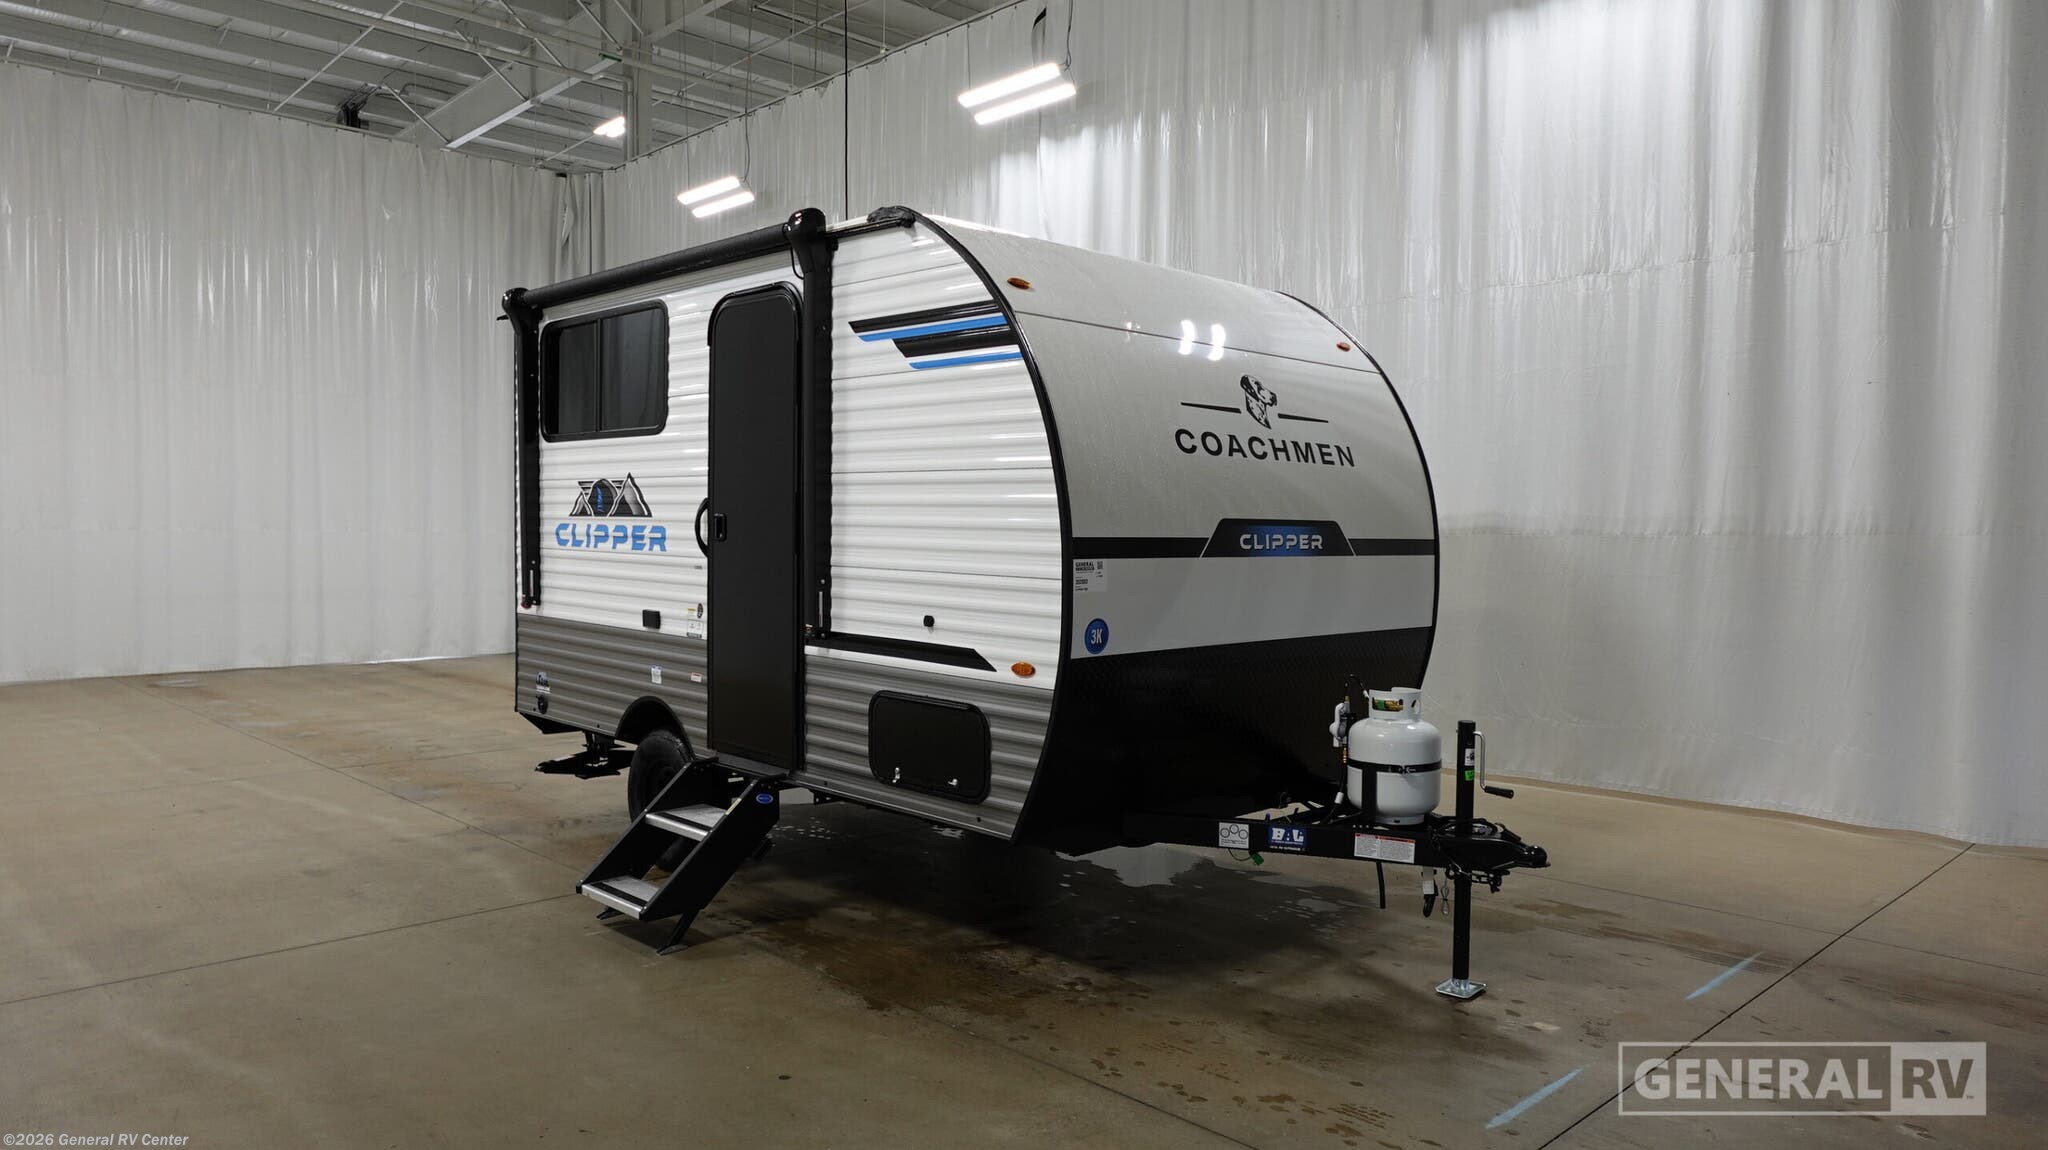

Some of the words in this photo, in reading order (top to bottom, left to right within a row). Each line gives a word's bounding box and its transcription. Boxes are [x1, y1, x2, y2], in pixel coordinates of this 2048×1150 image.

[1175, 428, 1355, 467] COACHMEN
[555, 523, 667, 552] CLIPPER
[1239, 534, 1323, 550] CLIPPER
[1091, 629, 1103, 644] 3K
